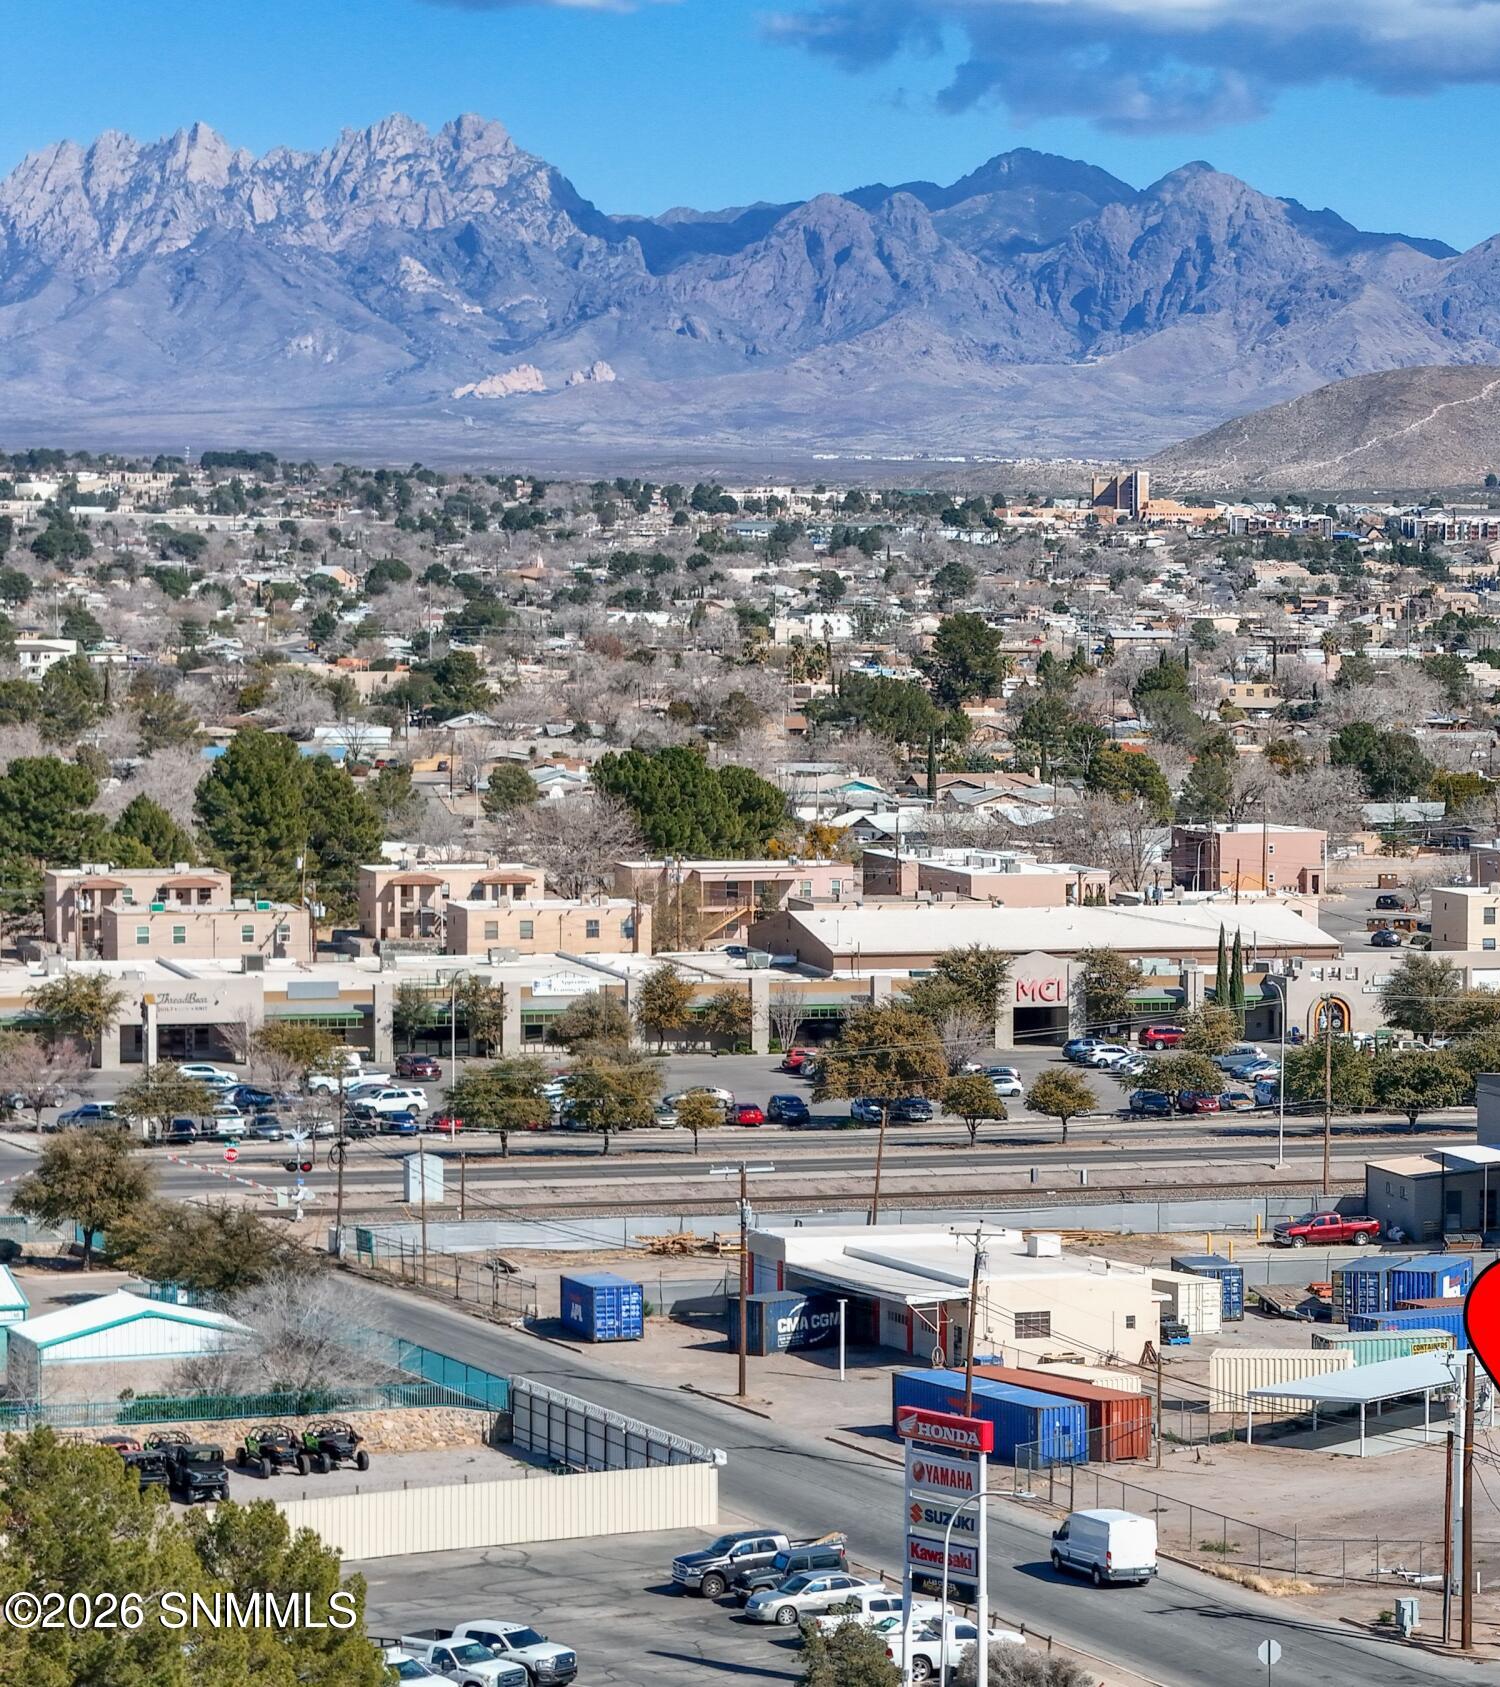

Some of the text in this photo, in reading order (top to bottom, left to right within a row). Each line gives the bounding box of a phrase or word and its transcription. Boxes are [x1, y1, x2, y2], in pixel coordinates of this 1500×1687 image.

[1016, 977, 1063, 1002] MCI
[777, 1316, 809, 1334] CMA
[1412, 1341, 1448, 1352] CONTAINERS
[918, 1422, 980, 1447] HONDA
[926, 1463, 974, 1492] YAMAHA
[924, 1509, 975, 1532] SUZUKI
[910, 1542, 972, 1571] Kawasaki
